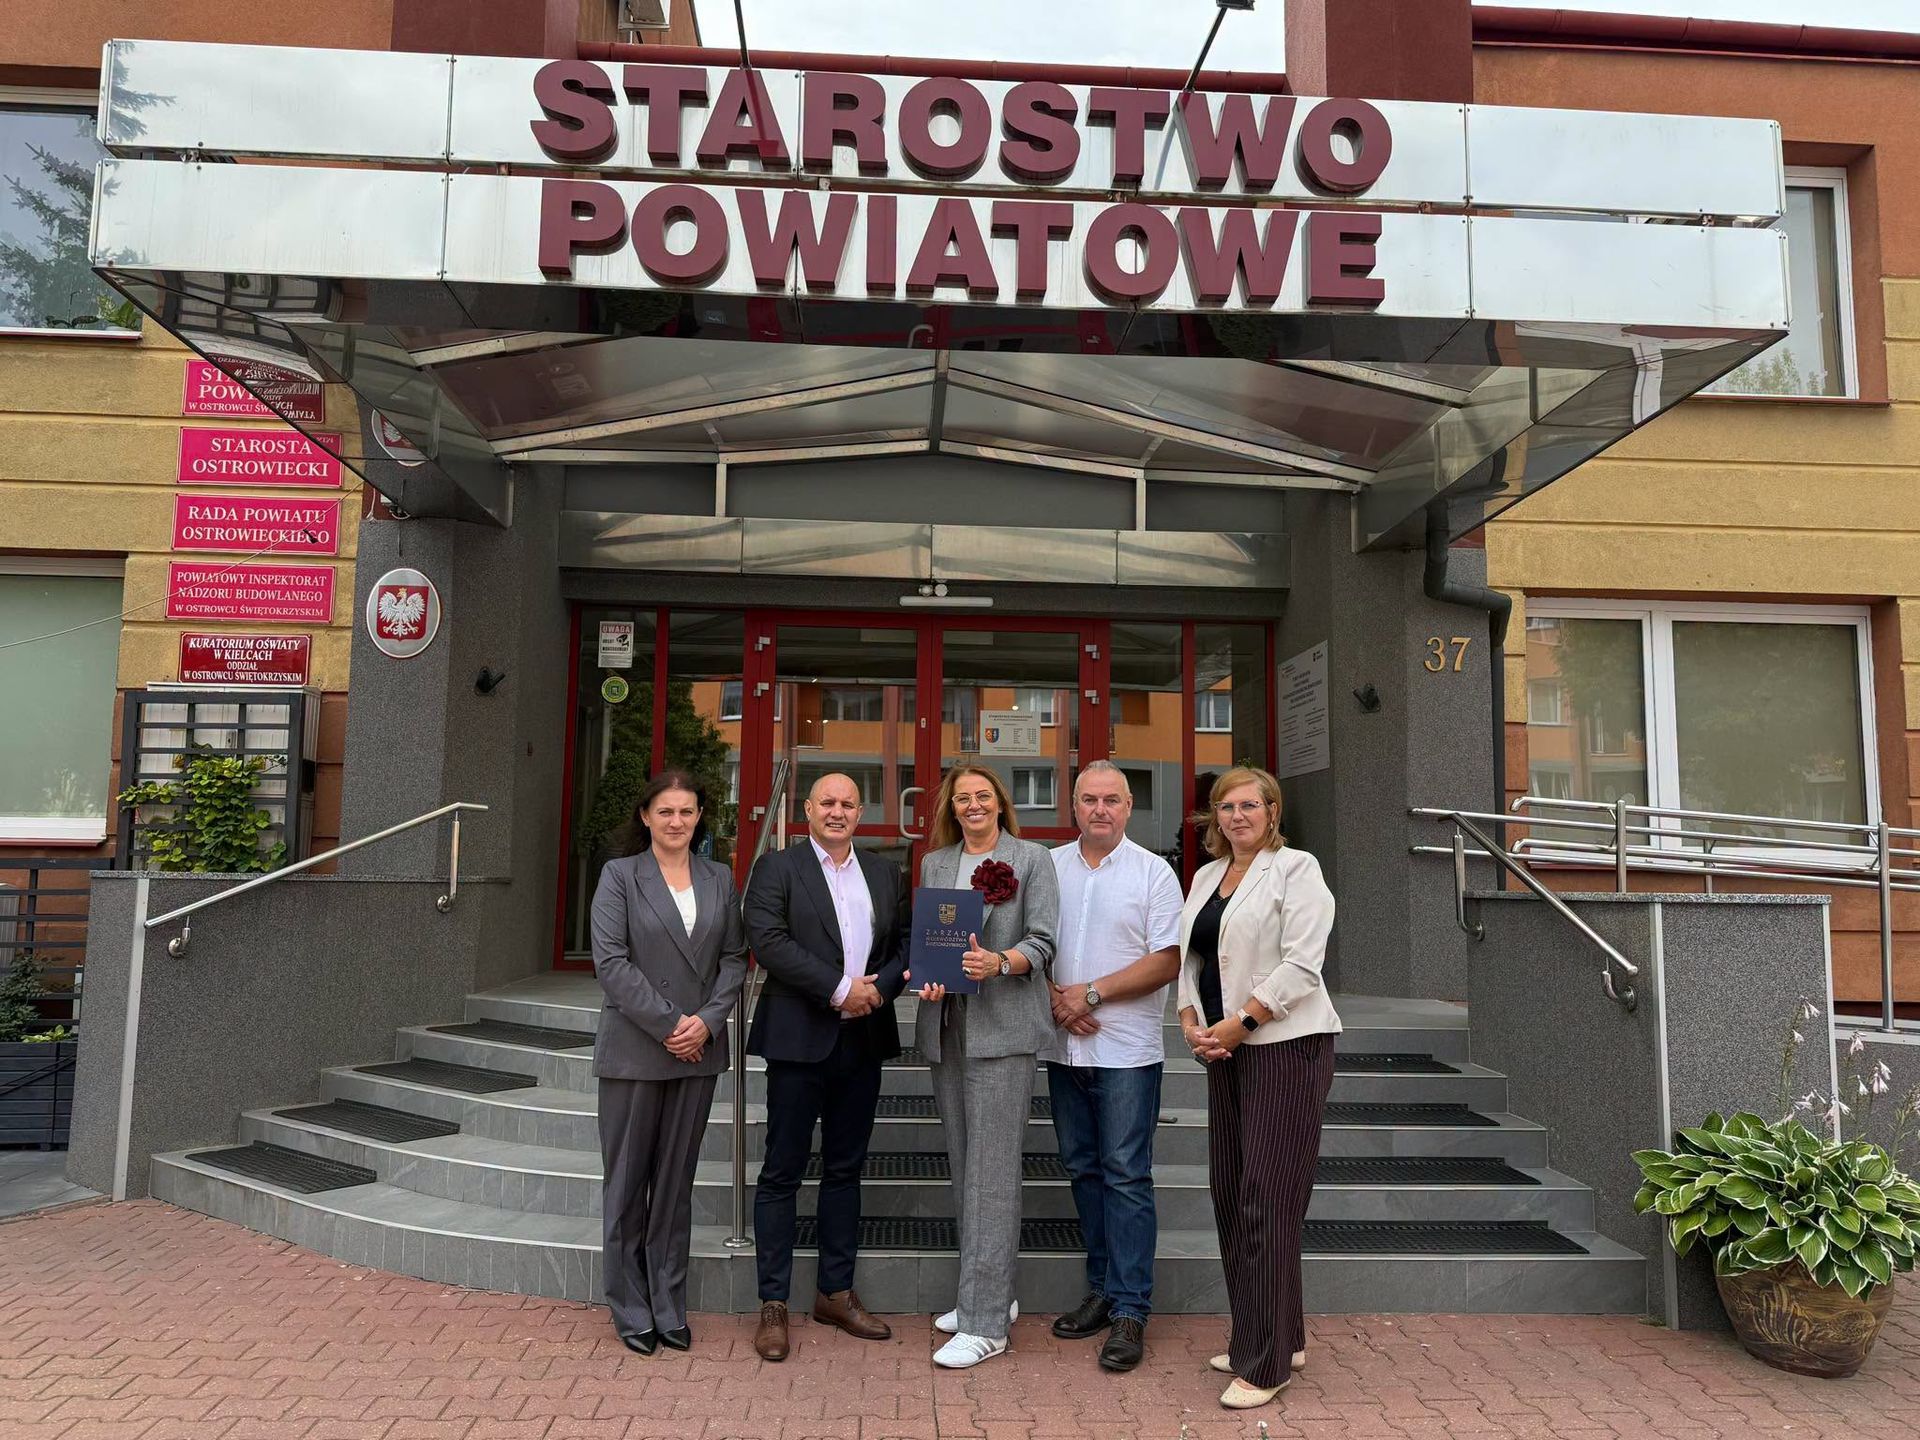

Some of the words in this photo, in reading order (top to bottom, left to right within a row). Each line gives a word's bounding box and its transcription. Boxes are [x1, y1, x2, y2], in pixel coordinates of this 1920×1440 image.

[529, 59, 1393, 196] STAROSTWO
[538, 179, 1386, 307] POWIATOWE
[189, 402, 199, 410] W
[200, 402, 253, 412] OSTROWCU
[211, 438, 312, 454] STAROSTA
[193, 459, 329, 477] OSTROWIECKI
[188, 506, 239, 521] RADA
[243, 508, 326, 523] POWIATU
[182, 527, 330, 544] OSTROWIECKIEGO
[176, 572, 247, 584] POWIATOWY
[249, 574, 327, 587] INSPEKTORAT
[177, 587, 233, 599] NADZORU
[236, 588, 323, 602] BUDOWLANEGO
[175, 604, 185, 612] W
[186, 605, 238, 614] OSTROWCU
[240, 604, 324, 617] ŚWIĘTOKRZYSKIM
[189, 638, 254, 649] KURATORIUM
[255, 637, 301, 651] OŚWIATY
[214, 650, 224, 660] W
[224, 650, 273, 661] KIELCACH
[1424, 637, 1471, 673] 37
[226, 662, 259, 671] ODDZIAŁ
[184, 672, 192, 680] W
[192, 672, 235, 681] OSTROWCU
[235, 671, 302, 683] ŚWIĘTOKRZYSKIM
